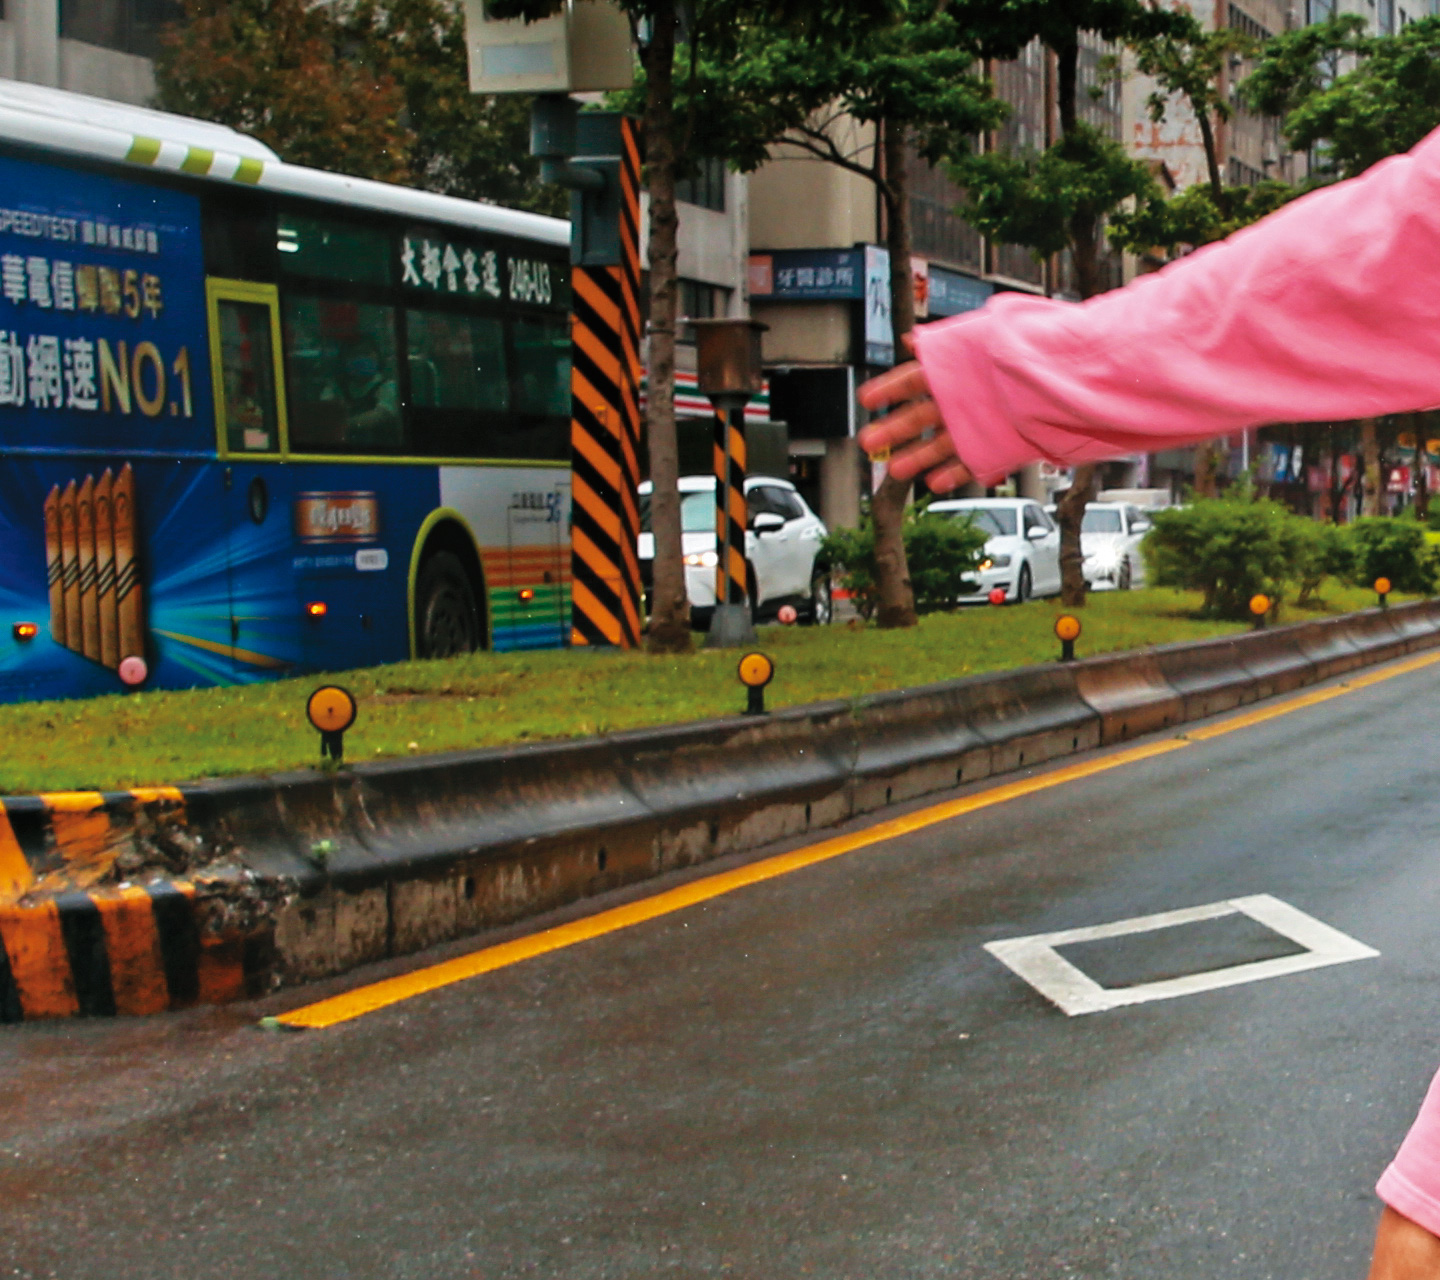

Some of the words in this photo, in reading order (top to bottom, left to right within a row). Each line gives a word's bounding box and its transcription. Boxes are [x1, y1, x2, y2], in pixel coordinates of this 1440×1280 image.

[400, 236, 502, 298] 大都會客運
